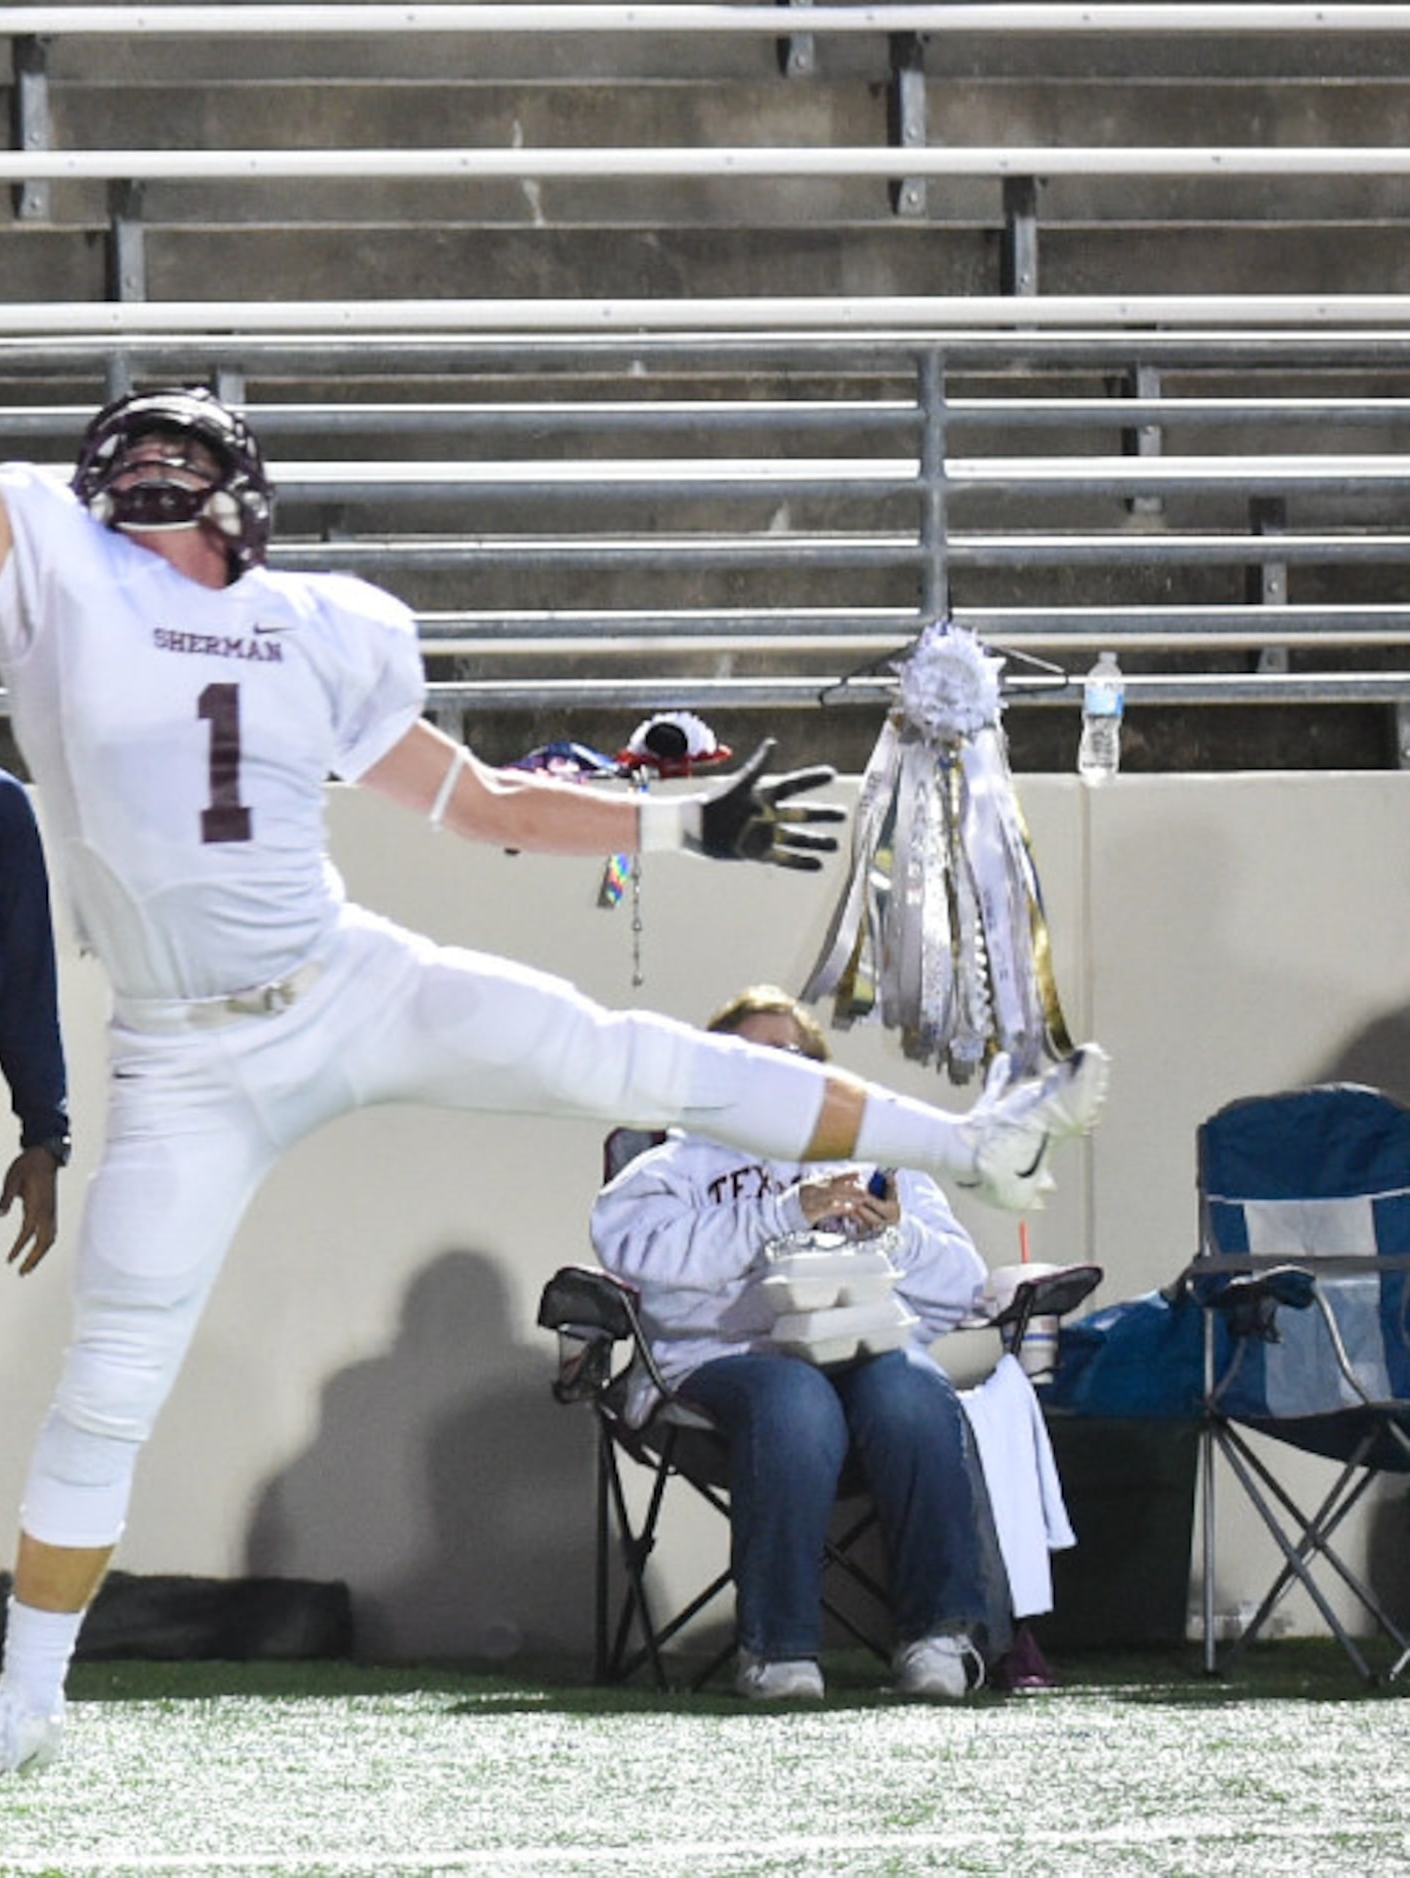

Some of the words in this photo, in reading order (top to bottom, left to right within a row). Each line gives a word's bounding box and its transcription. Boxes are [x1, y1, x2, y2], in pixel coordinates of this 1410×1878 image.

[152, 627, 283, 662] SHERMAN
[196, 682, 253, 844] 1
[707, 1164, 803, 1204] TEX
